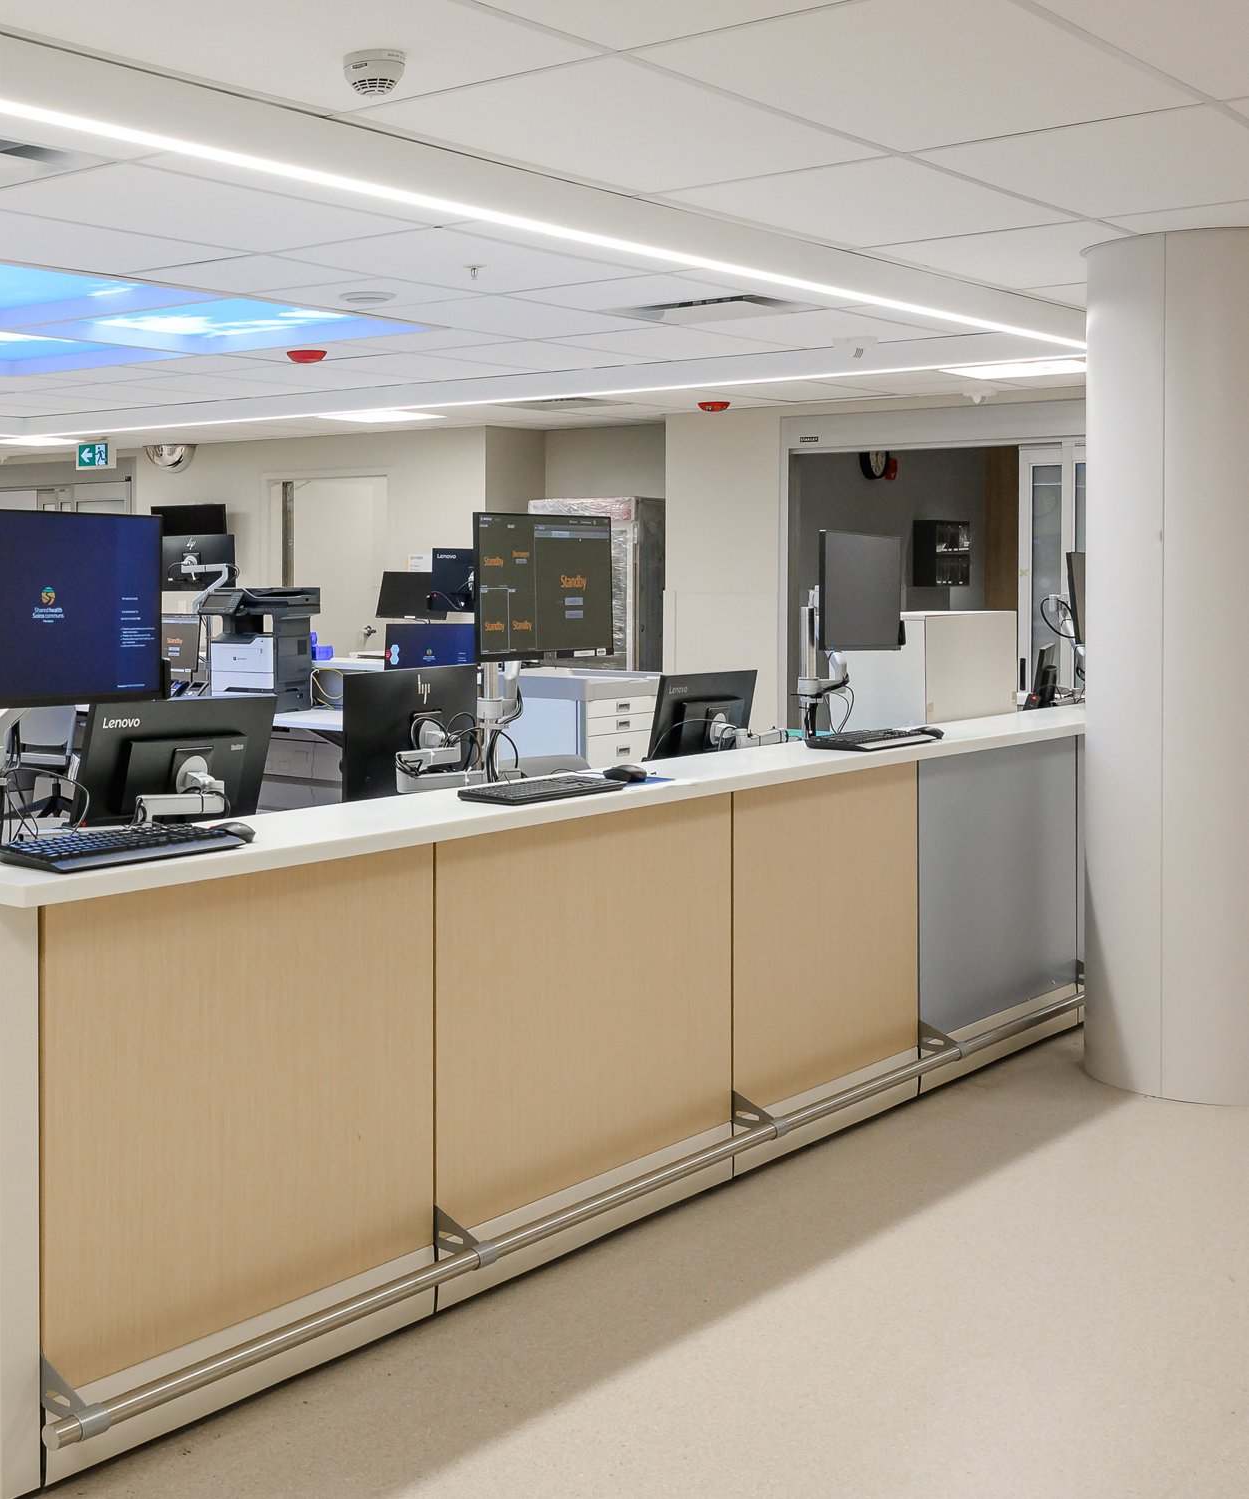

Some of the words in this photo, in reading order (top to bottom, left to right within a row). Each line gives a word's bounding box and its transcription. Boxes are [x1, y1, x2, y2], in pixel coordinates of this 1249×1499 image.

[483, 556, 504, 568] Standby
[560, 574, 587, 590] Standby
[484, 621, 506, 633] Standby
[512, 620, 533, 632] Standby
[668, 685, 688, 695] Lenovo
[102, 717, 141, 729] Lenovo
